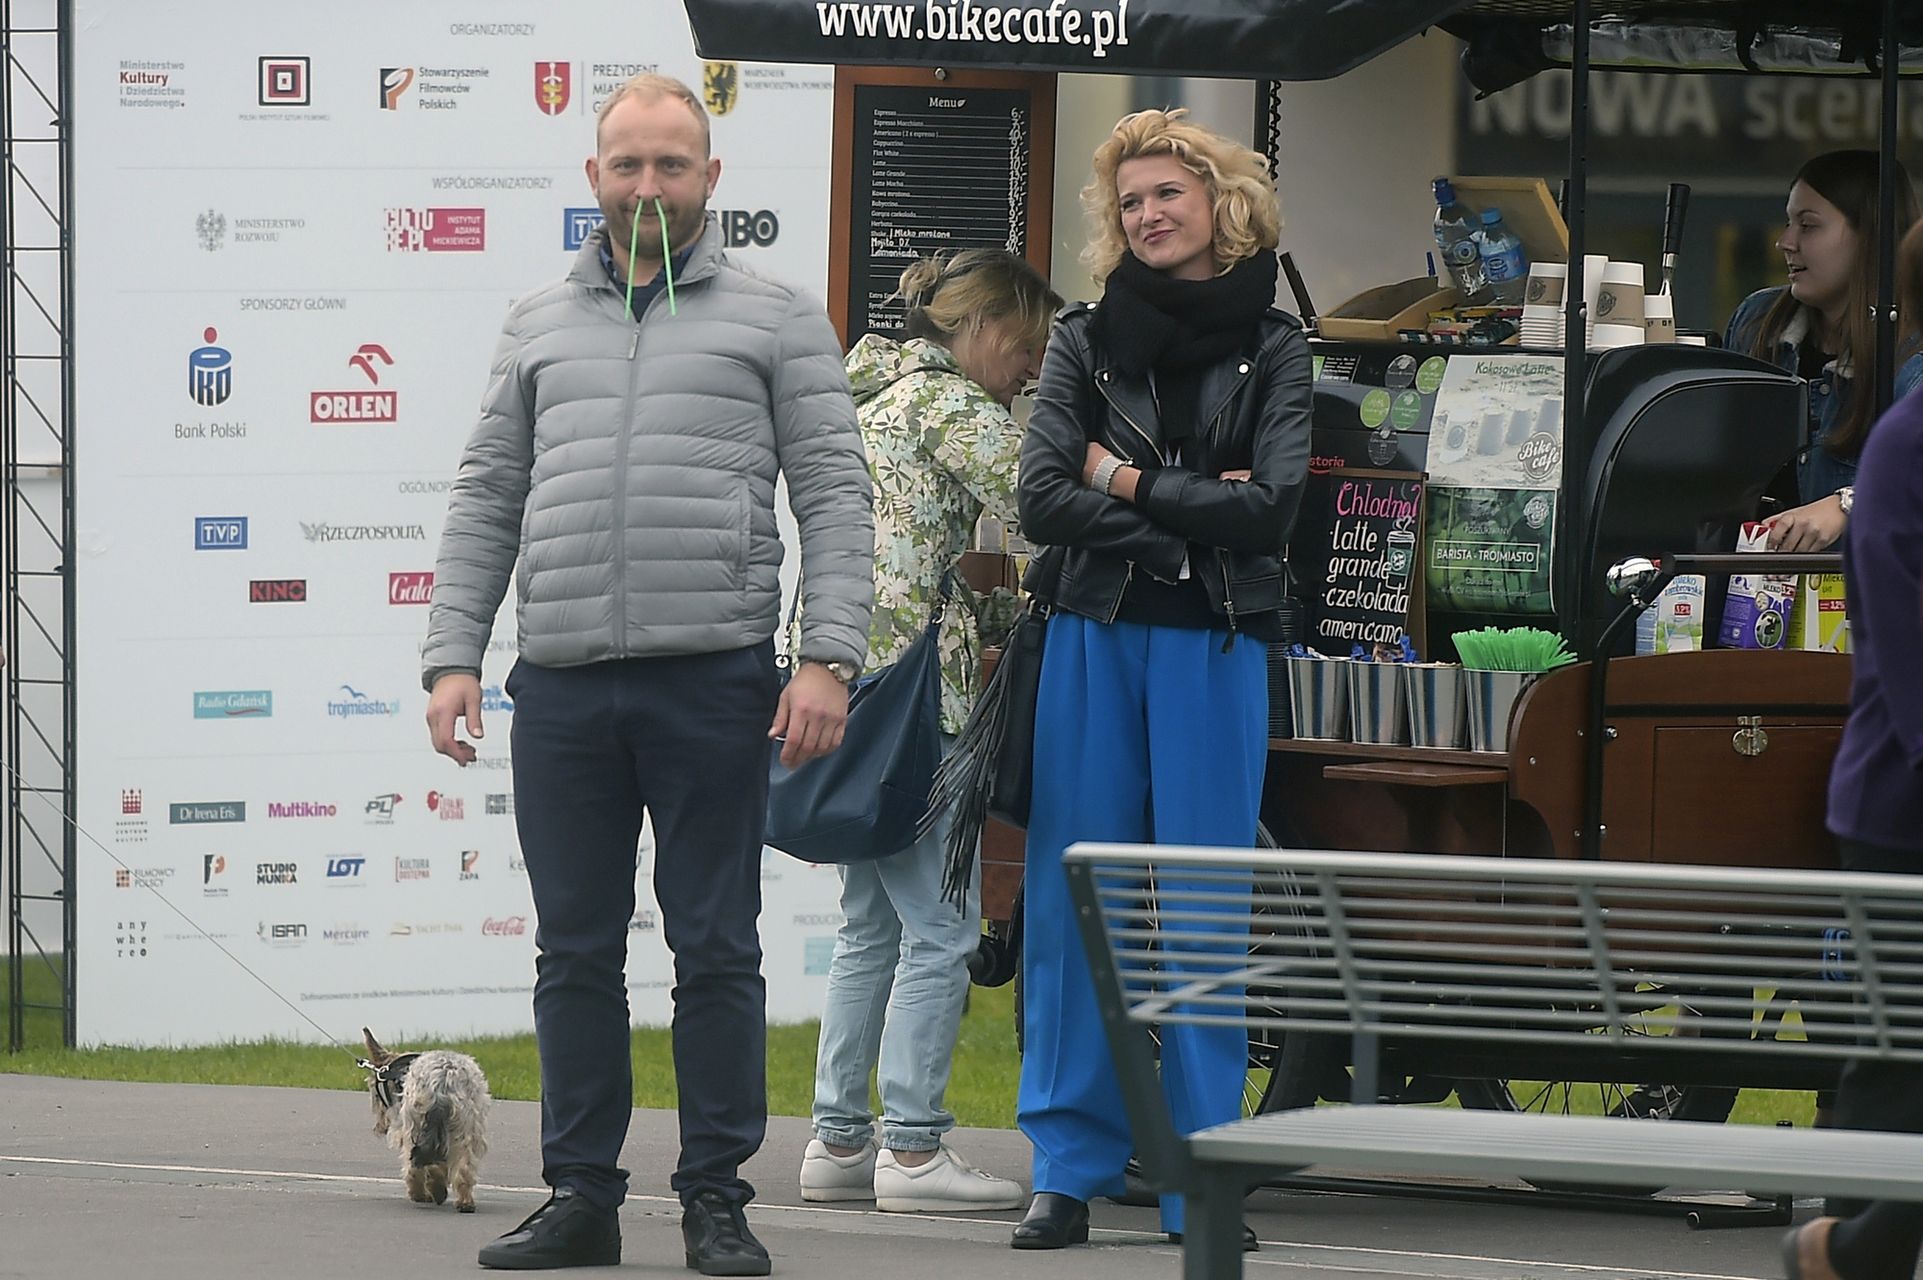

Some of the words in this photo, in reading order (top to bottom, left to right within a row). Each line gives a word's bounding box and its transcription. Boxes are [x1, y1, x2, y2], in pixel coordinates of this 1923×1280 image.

[450, 24, 535, 36] ORGANIZATORZY
[817, 1, 1128, 57] www.bikecafe.pl
[119, 60, 185, 70] Ministerstwo
[418, 66, 490, 79] Stowarzyszenie
[119, 71, 169, 87] Kultury
[126, 86, 185, 96] Dziedzictwa
[418, 83, 471, 94] Filmowców
[418, 98, 457, 110] Polskich
[929, 97, 957, 108] Menu
[235, 219, 305, 230] MINISTERSTWO
[235, 232, 280, 243] ROZWOJU
[240, 299, 302, 311] SPONSORZY
[314, 395, 392, 419] ORLEN
[174, 423, 207, 439] Bank
[210, 421, 247, 438] Polski
[1519, 440, 1552, 461] Bike
[1532, 447, 1560, 472] cafe
[203, 523, 240, 543] TVP
[1332, 519, 1378, 552] latte
[1436, 548, 1473, 560] BARISTA
[1326, 549, 1392, 583] grande
[251, 580, 305, 601] KINO
[390, 575, 434, 604] Gala
[1325, 580, 1409, 613] czekolada
[1319, 617, 1404, 645] americano
[328, 699, 400, 720] trojmiasto.pl
[179, 807, 194, 820] Dr
[220, 805, 237, 819] Eris
[268, 801, 337, 818] Multikino
[256, 863, 298, 874] STUDIO
[326, 858, 366, 877] LOT
[256, 874, 298, 885] MUNKA
[459, 873, 480, 881] ZAPA
[322, 929, 370, 941] Mercure
